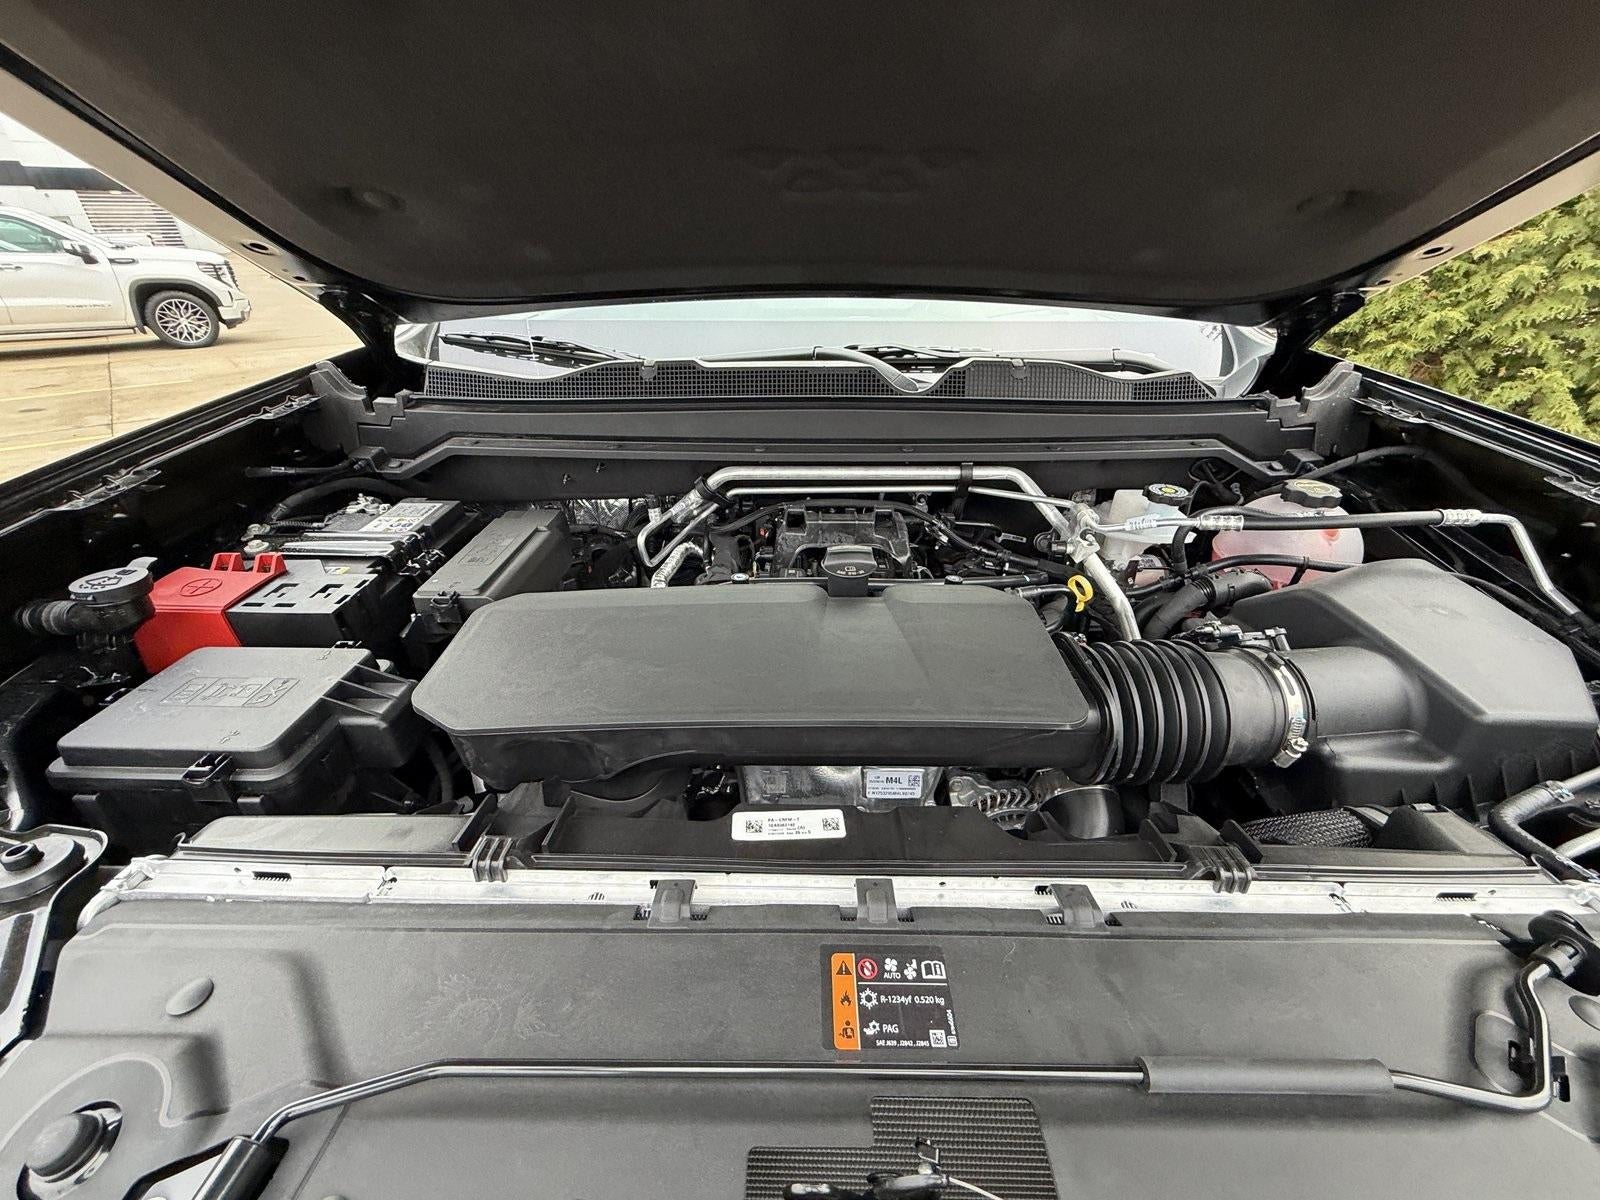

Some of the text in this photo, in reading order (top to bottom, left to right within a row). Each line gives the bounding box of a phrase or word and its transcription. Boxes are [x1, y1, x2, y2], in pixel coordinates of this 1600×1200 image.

[885, 776, 903, 785] M4L
[880, 995, 945, 1006] R-1234yf 0.520 kg
[882, 1023, 899, 1033] PAG
[875, 1039, 886, 1047] SAE
